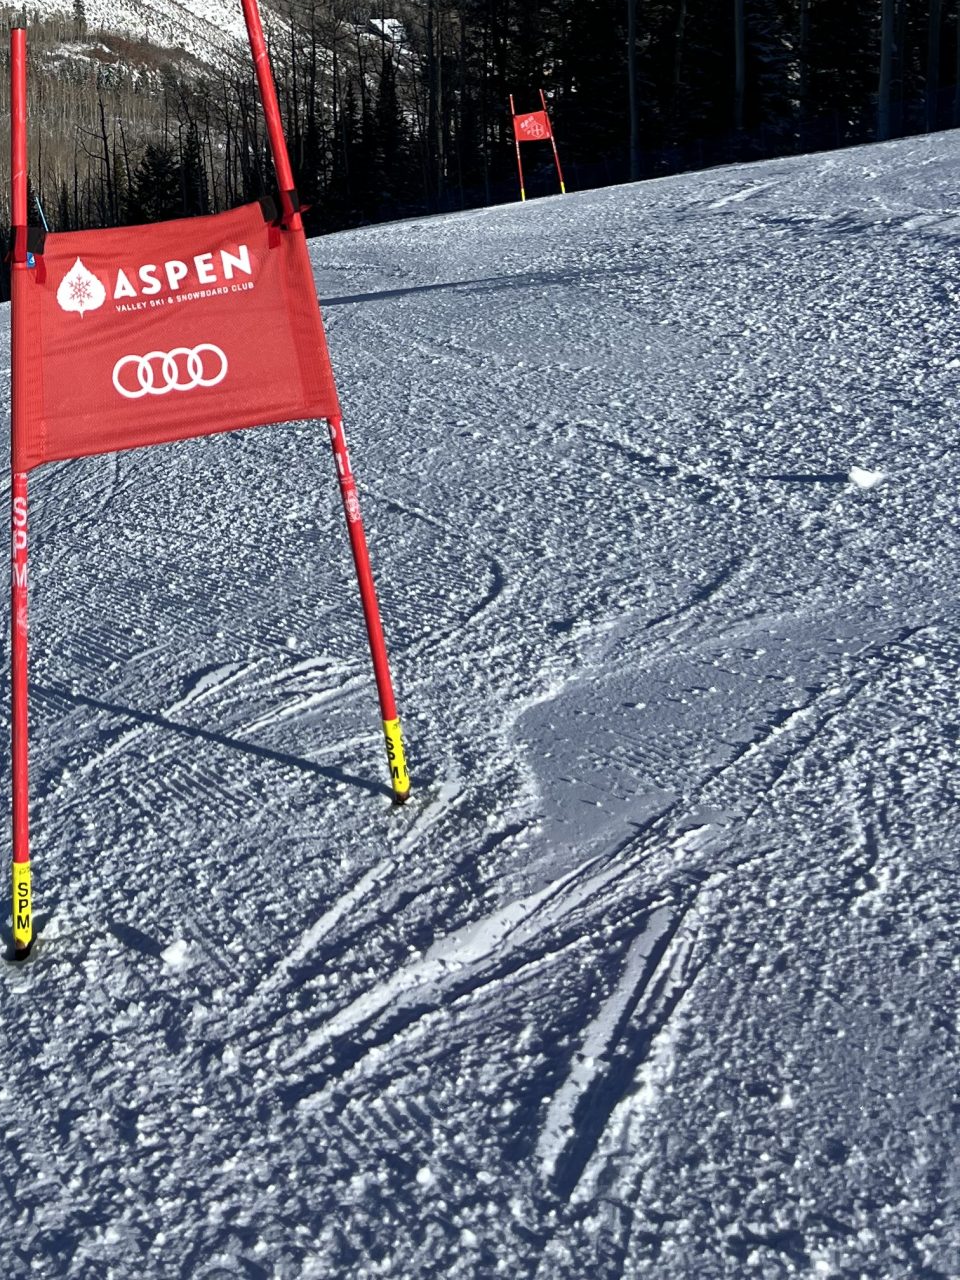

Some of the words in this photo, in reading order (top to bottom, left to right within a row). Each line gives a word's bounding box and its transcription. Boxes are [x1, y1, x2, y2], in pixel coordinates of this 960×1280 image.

[113, 244, 252, 299] ASPEN
[115, 301, 147, 312] VALLEY
[150, 298, 165, 307] SKI
[176, 287, 229, 302] SNOWBOARD
[231, 281, 255, 292] CLUB
[12, 496, 28, 588] SPM
[17, 882, 30, 929] SPM
